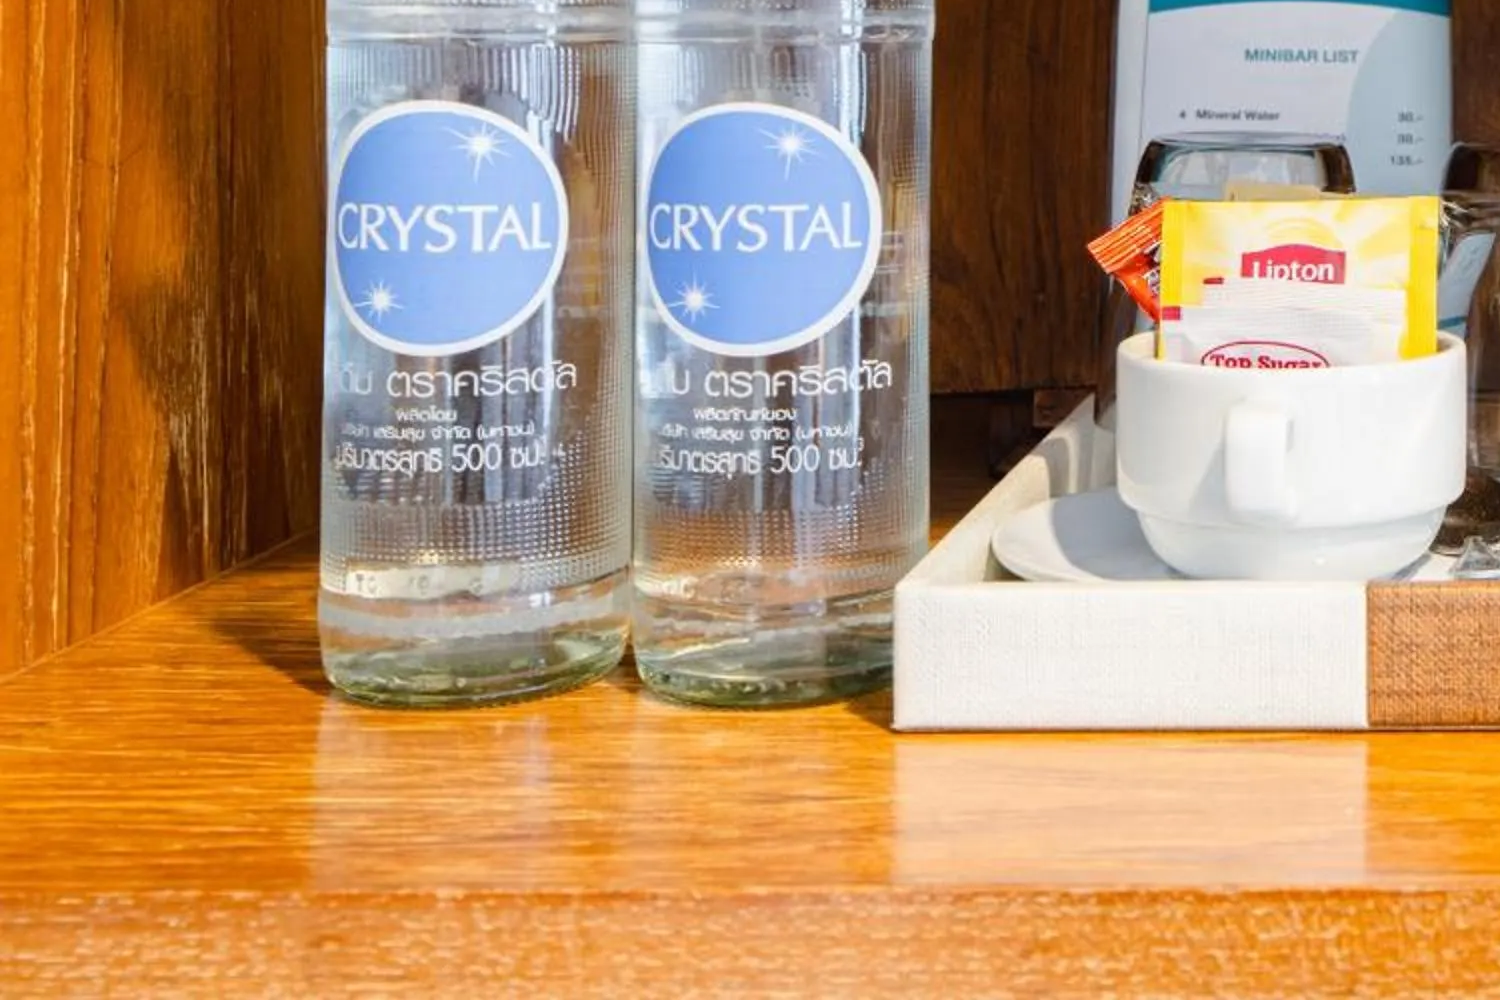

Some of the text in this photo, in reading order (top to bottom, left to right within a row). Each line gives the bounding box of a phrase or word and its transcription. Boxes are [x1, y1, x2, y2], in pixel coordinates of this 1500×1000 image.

[1244, 48, 1359, 64] MINIBAR LIST
[1196, 108, 1241, 121] Mineral
[1244, 109, 1280, 121] Water
[337, 202, 553, 254] CRYSTAL
[649, 202, 863, 253] CRYSTAL
[1251, 259, 1336, 281] Lipton
[450, 441, 502, 472] 500
[769, 443, 821, 474] 500
